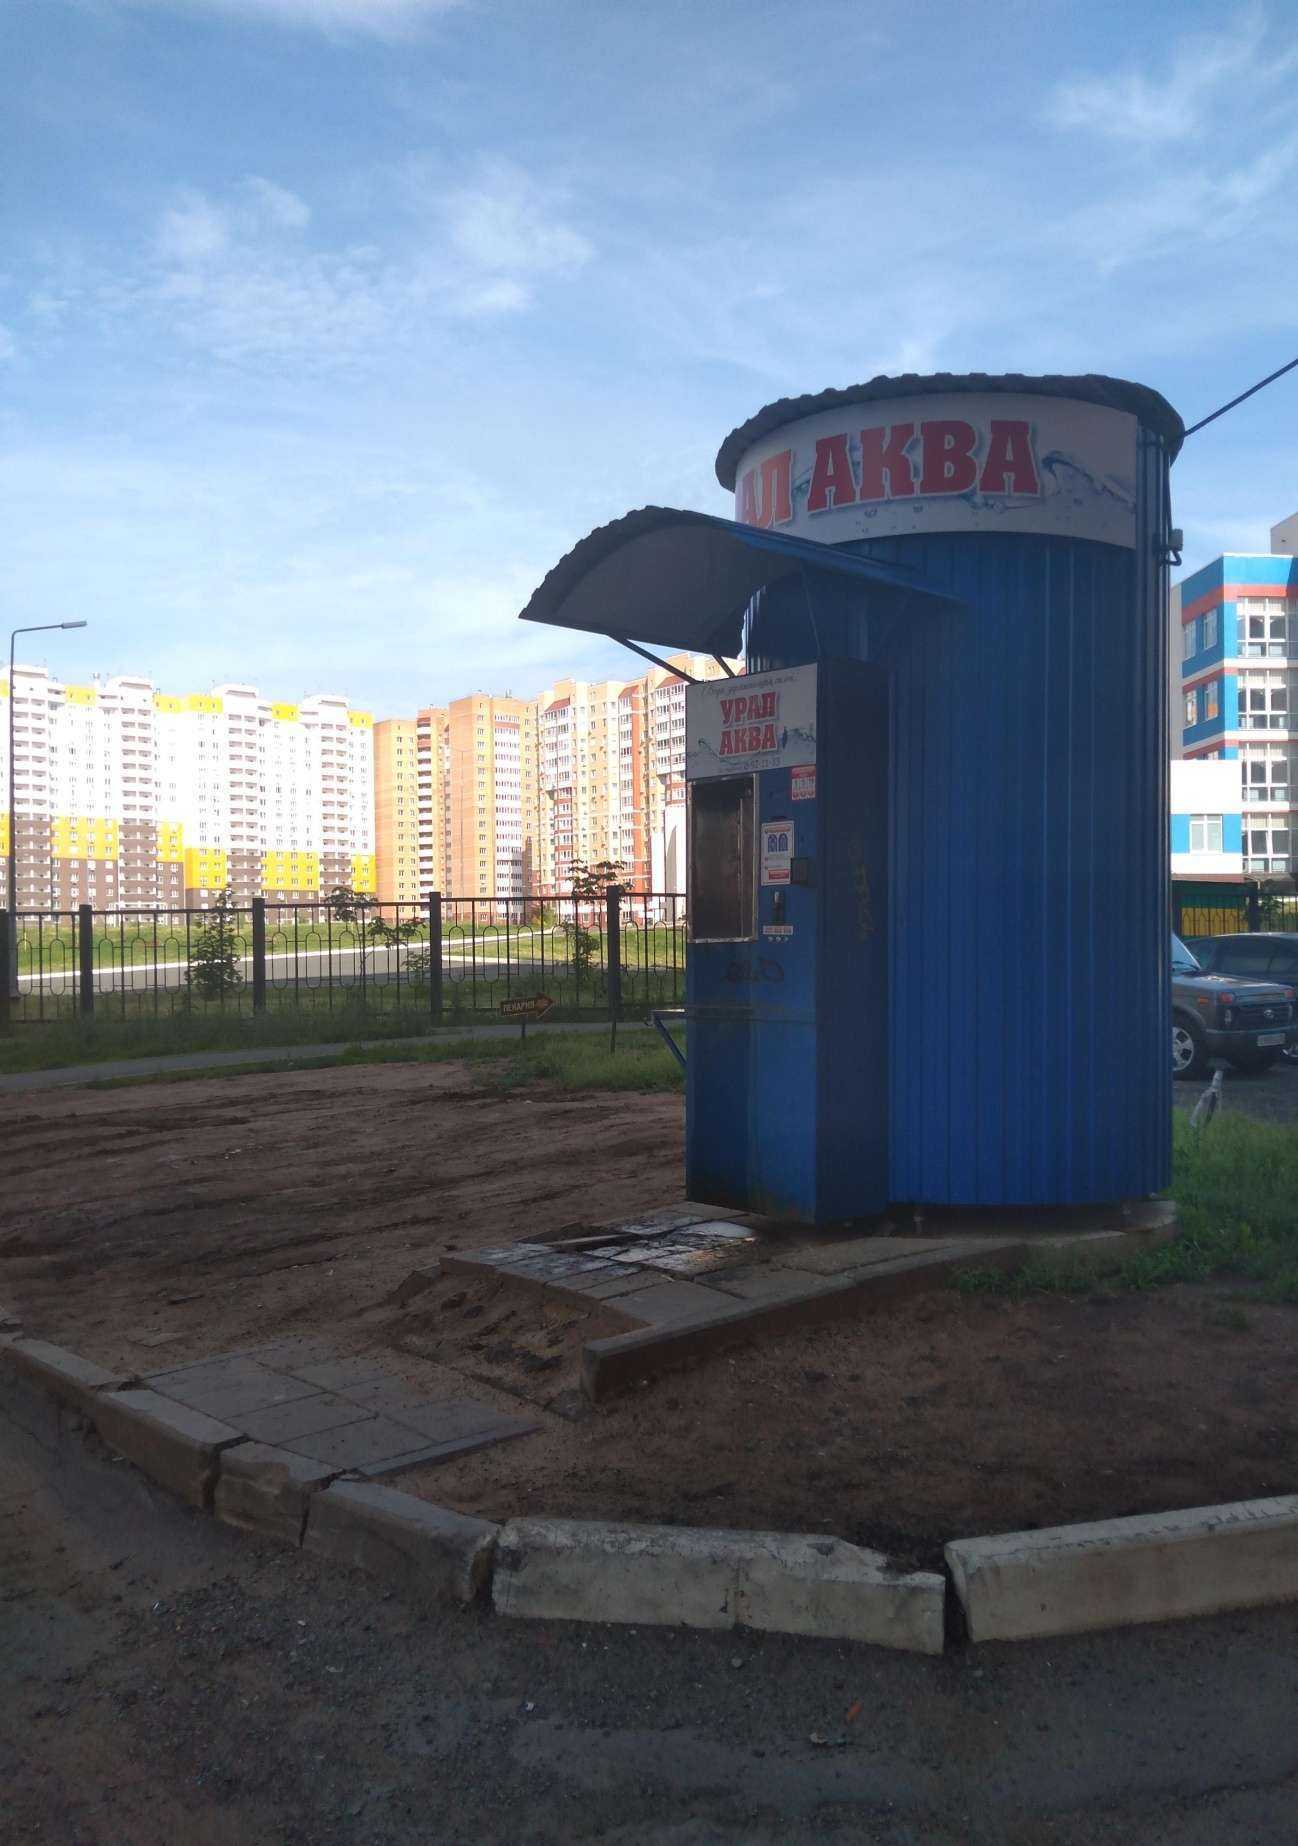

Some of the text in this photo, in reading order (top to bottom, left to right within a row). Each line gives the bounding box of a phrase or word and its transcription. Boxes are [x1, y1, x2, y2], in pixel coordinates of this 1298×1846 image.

[807, 420, 1040, 511] АКВА
[720, 691, 777, 725] УРАЛ
[719, 723, 777, 756] АКВА
